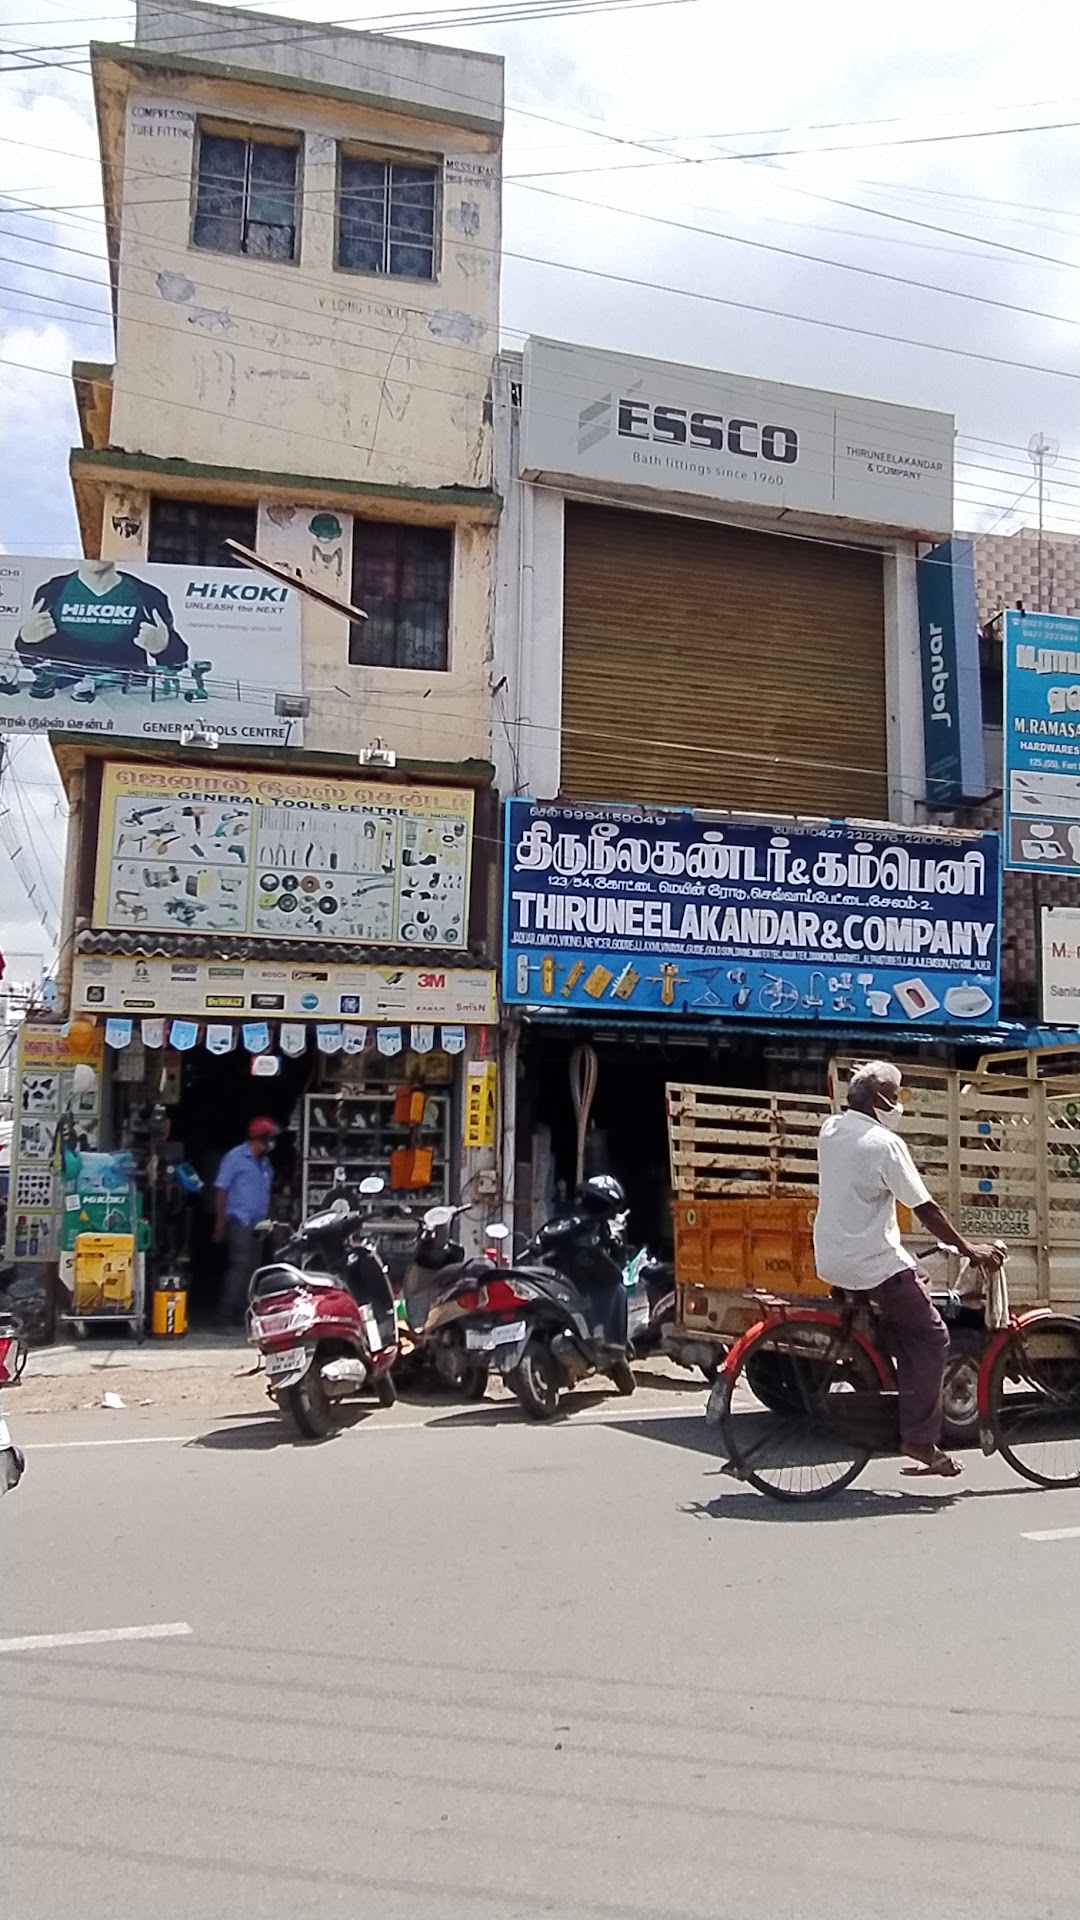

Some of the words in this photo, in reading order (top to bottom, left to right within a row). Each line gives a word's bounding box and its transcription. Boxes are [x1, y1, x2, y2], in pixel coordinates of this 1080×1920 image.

[617, 398, 799, 464] ESSCO
[846, 446, 943, 471] THIRUNEELAKANDAR
[632, 451, 662, 466] Bath
[665, 456, 712, 476] fittings
[715, 467, 747, 480] since
[752, 471, 784, 487] 1960
[867, 463, 874, 472] &
[876, 464, 922, 480] COMPANY
[186, 582, 289, 602] HiKOKI
[61, 603, 138, 618] HiKOKI
[185, 602, 234, 612] UNLEASH
[255, 606, 285, 614] NEXT
[61, 616, 97, 624] UNLEASH
[28, 717, 65, 730] டூல்ஸ்
[67, 718, 114, 730] சென்டர்
[241, 727, 286, 738] CENTRE
[1020, 741, 1080, 755] HARDWARES
[257, 780, 348, 801] டூல்ஸ்
[177, 792, 265, 806] GENERAL
[271, 799, 331, 811] TOOLS
[337, 804, 409, 817] CENTRE
[658, 881, 706, 895] மெயின்
[417, 973, 446, 988] 3M
[765, 1258, 792, 1272] HORN
